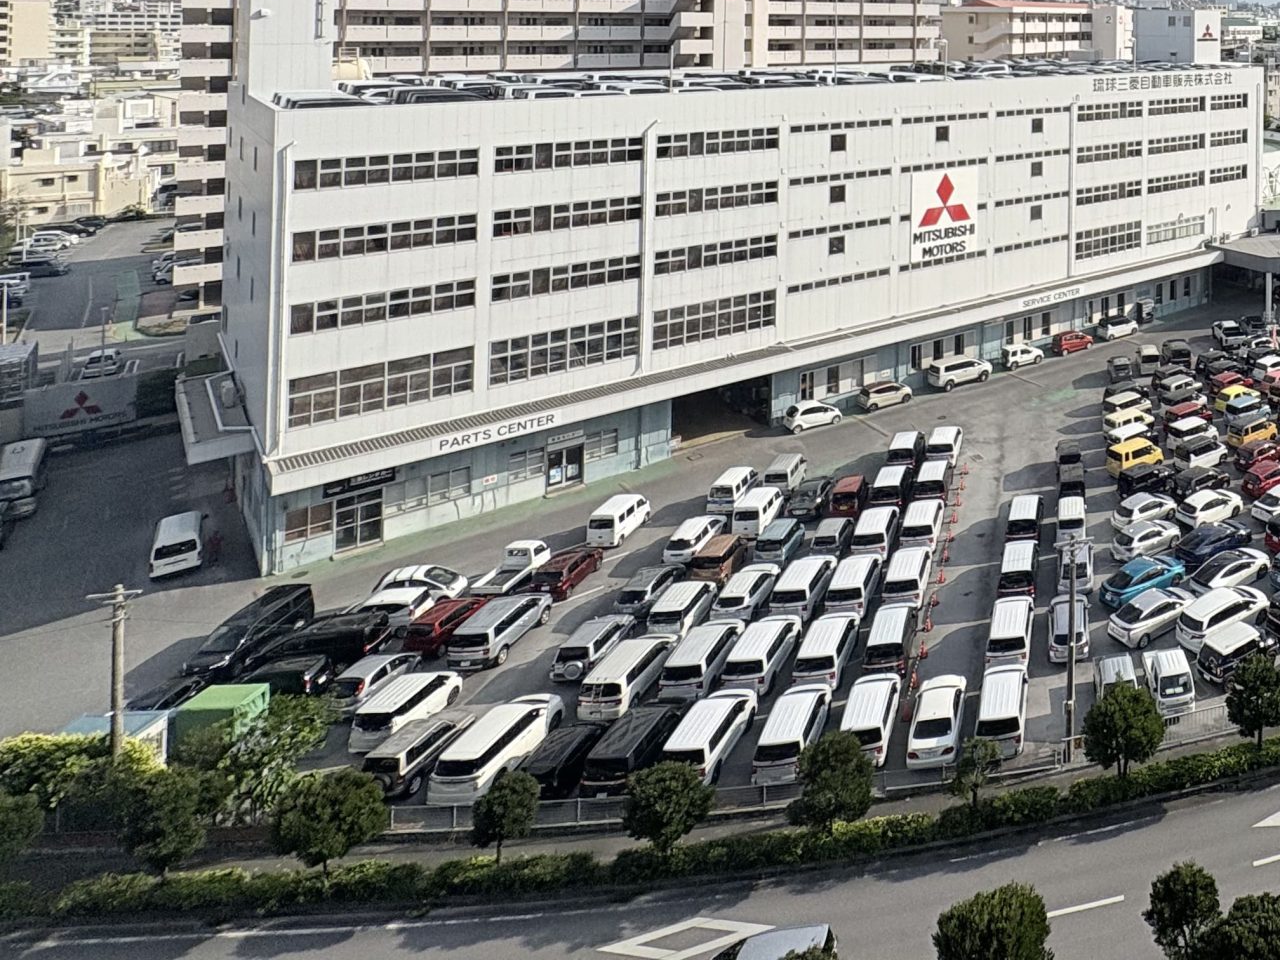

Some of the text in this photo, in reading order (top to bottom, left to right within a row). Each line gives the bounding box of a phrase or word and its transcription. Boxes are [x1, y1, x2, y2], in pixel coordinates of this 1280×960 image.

[1105, 15, 1112, 24] 2
[1092, 71, 1233, 92] 琉球三菱自動車販売株式会社
[913, 223, 975, 245] MITSUBISHI
[922, 240, 966, 259] MOTORS
[1022, 288, 1080, 307] SERVICE CENTER
[439, 429, 491, 451] PARTS
[497, 414, 555, 436] CENTER
